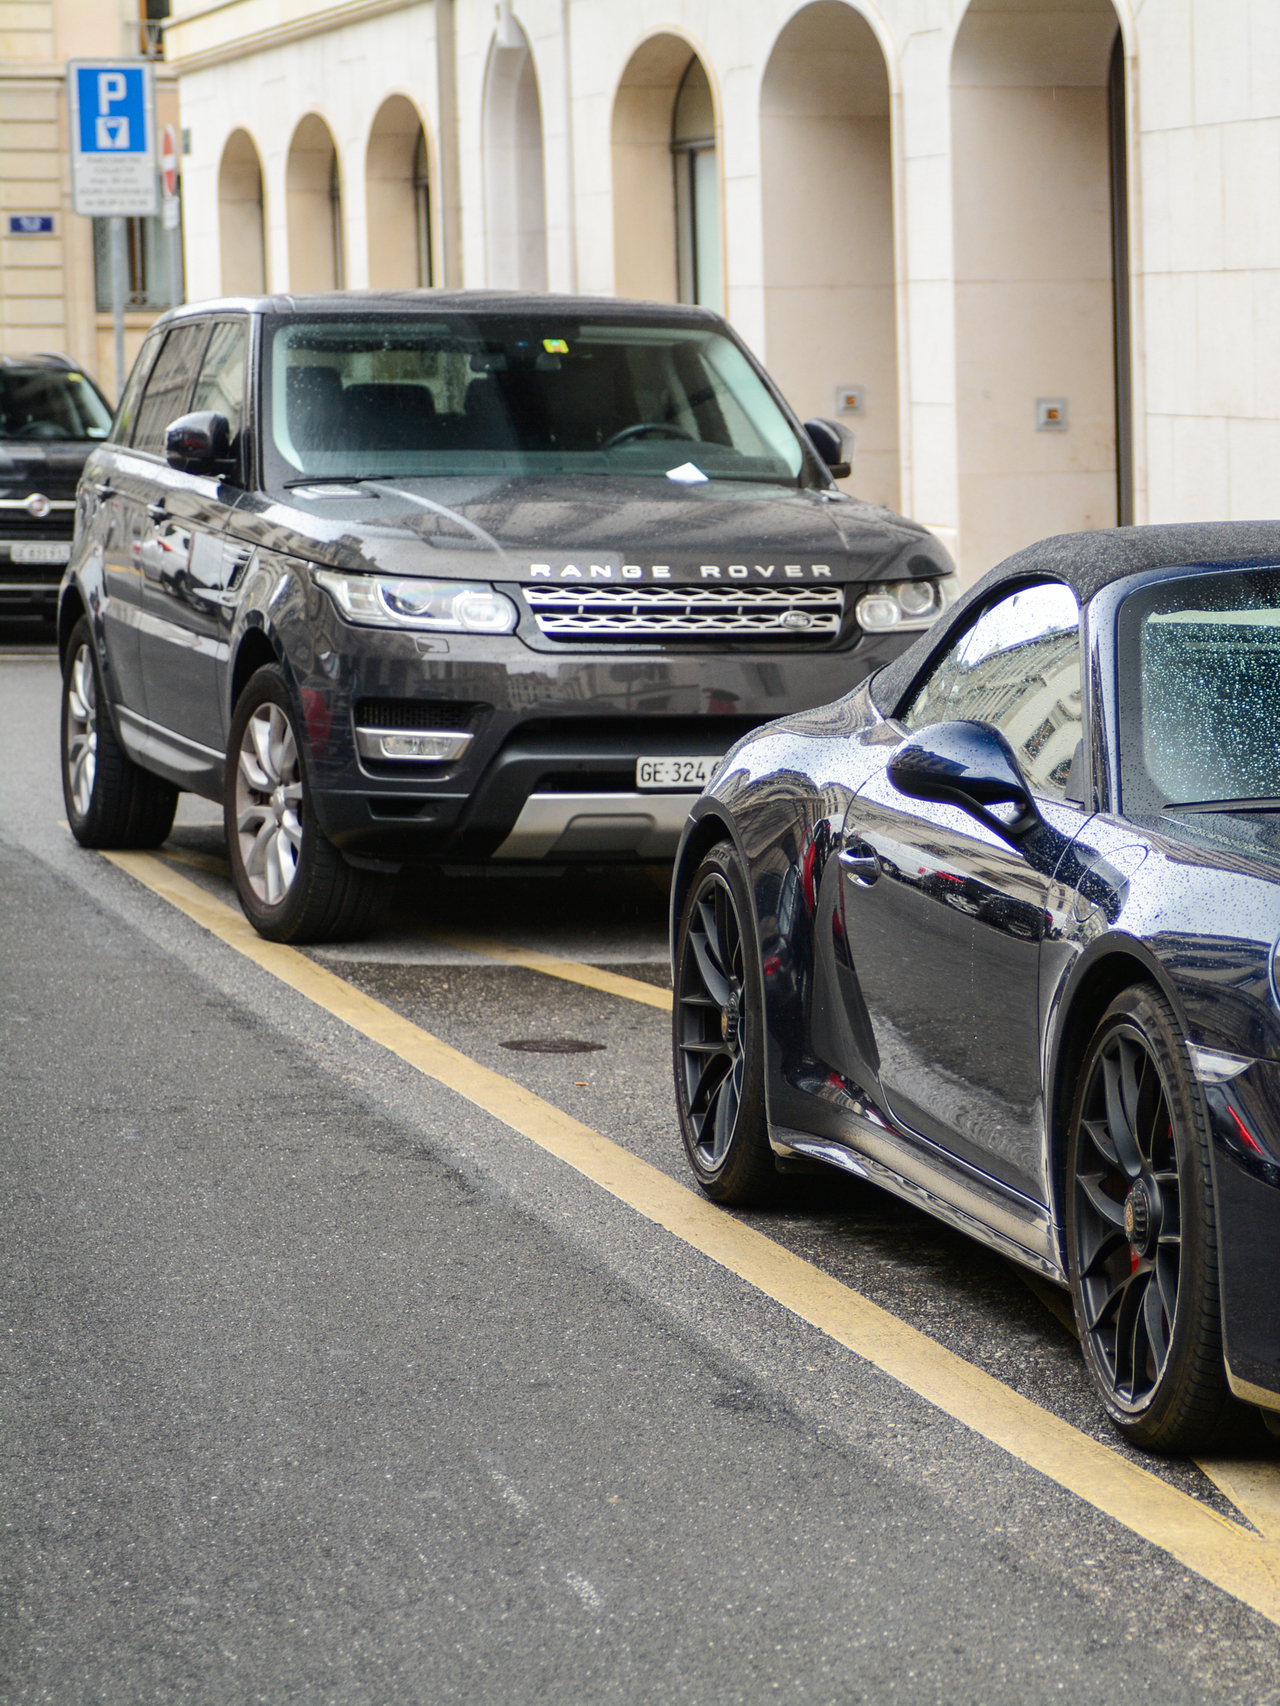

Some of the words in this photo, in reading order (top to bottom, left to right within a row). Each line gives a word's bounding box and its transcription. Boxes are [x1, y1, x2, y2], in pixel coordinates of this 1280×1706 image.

[97, 72, 127, 115] P
[530, 563, 672, 579] RANGE
[700, 564, 833, 579] ROVER
